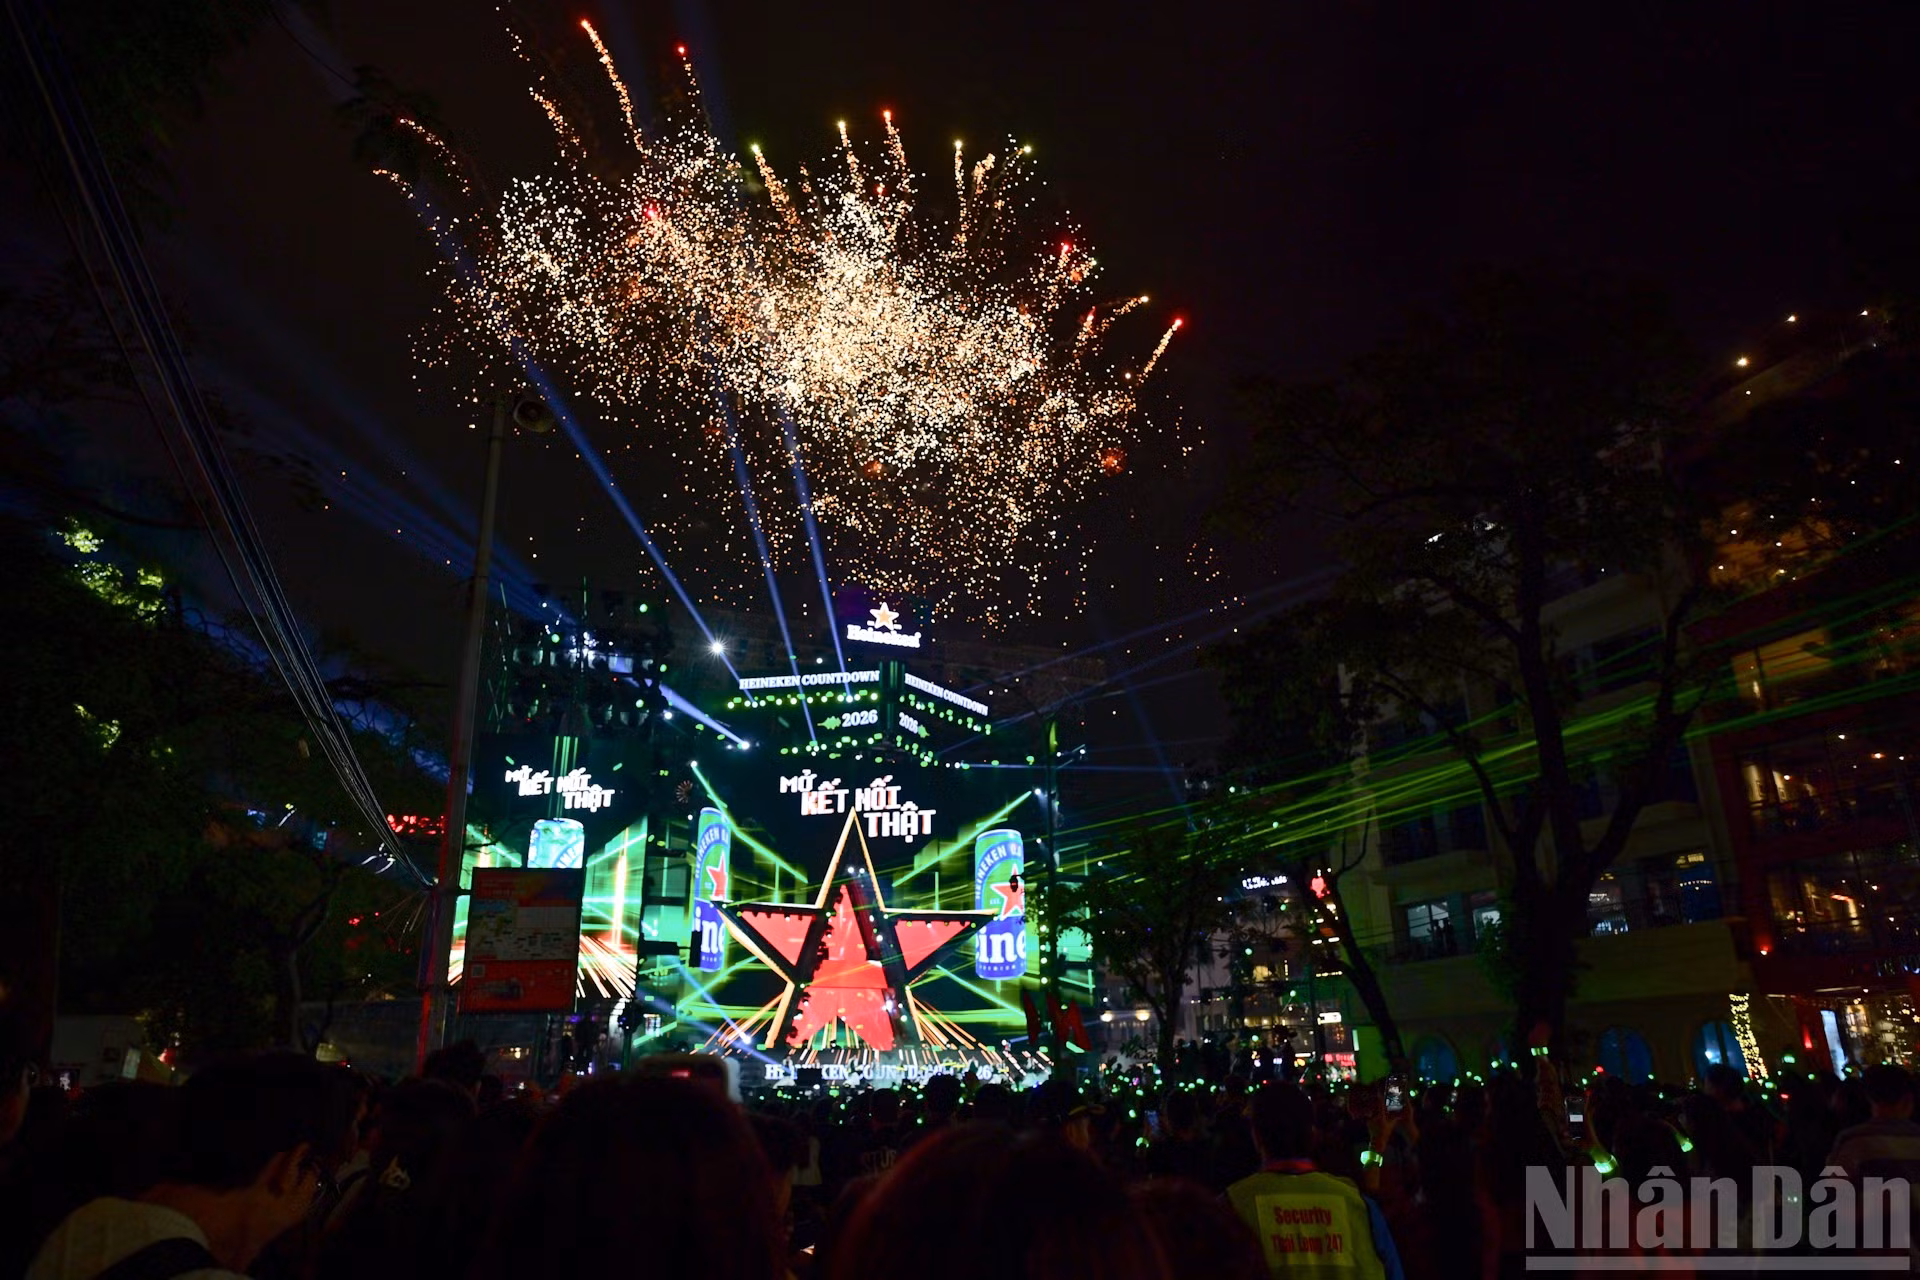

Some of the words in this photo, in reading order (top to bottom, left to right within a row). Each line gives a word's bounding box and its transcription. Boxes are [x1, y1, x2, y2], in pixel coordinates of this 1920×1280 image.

[847, 624, 922, 648] Heineken
[739, 675, 800, 689] HEINEKEN
[801, 670, 880, 687] COUNTDOWN
[904, 673, 944, 698] HEINEKEN
[943, 689, 989, 716] COUNTDOWN
[841, 709, 878, 727] 2026
[899, 711, 919, 734] 2026
[518, 770, 554, 796] KẾT
[779, 769, 817, 793] MỞ
[562, 784, 615, 813] THẬT
[801, 778, 849, 816] KẾT
[855, 775, 902, 812] NỐI
[863, 801, 936, 843] THẬT
[1274, 1206, 1332, 1226] Security
